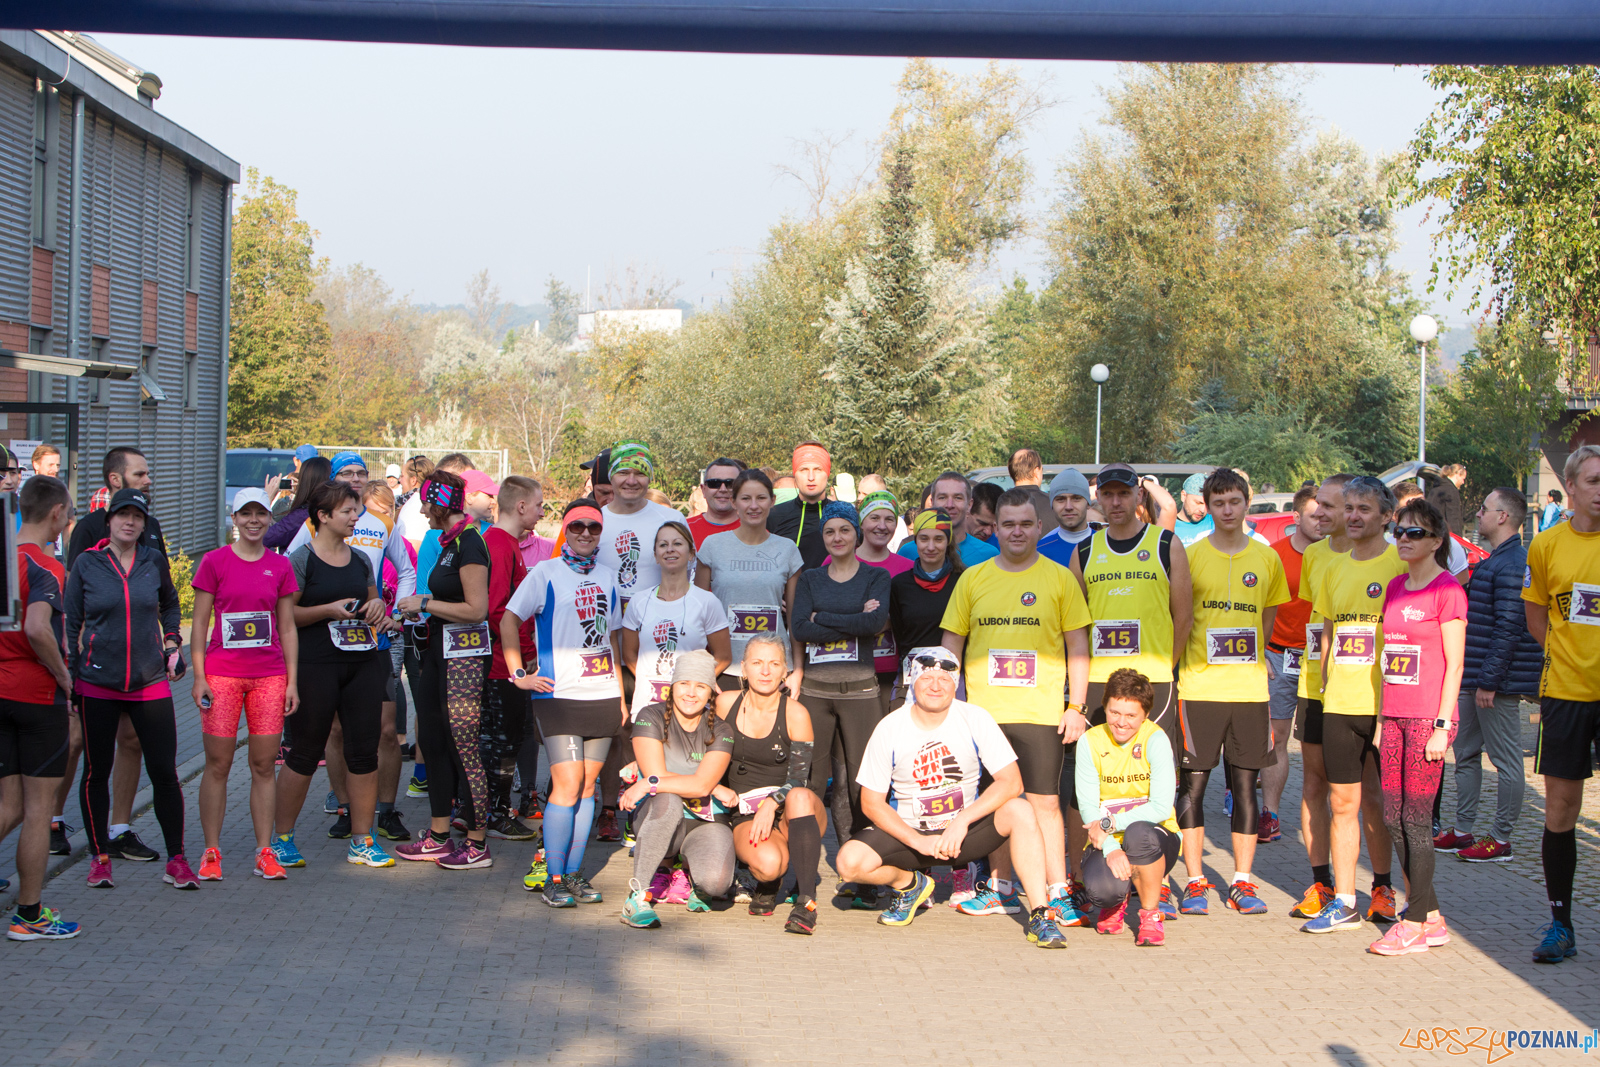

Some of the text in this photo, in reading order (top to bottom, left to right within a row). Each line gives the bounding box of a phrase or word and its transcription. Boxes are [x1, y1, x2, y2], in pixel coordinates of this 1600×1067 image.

[353, 527, 385, 539] polscy
[343, 536, 384, 549] GACZE
[730, 560, 771, 571] PUMA
[1088, 570, 1158, 584] LUBOŃ BIEGA
[574, 595, 597, 608] CZE
[1589, 597, 1600, 615] 3
[576, 606, 597, 621] WO
[978, 615, 1041, 627] LUBOŃ BIEGA
[244, 622, 257, 638] 9
[744, 615, 769, 631] 92
[346, 629, 367, 643] 55
[458, 632, 481, 647] 38
[876, 632, 885, 647] 7
[1107, 630, 1131, 646] 15
[1224, 638, 1248, 654] 16
[1342, 637, 1366, 654] 45
[591, 656, 610, 674] 34
[1003, 660, 1027, 677] 18
[1389, 656, 1411, 673] 47
[660, 685, 671, 701] 8
[912, 760, 942, 779] CZE
[931, 796, 955, 814] 51
